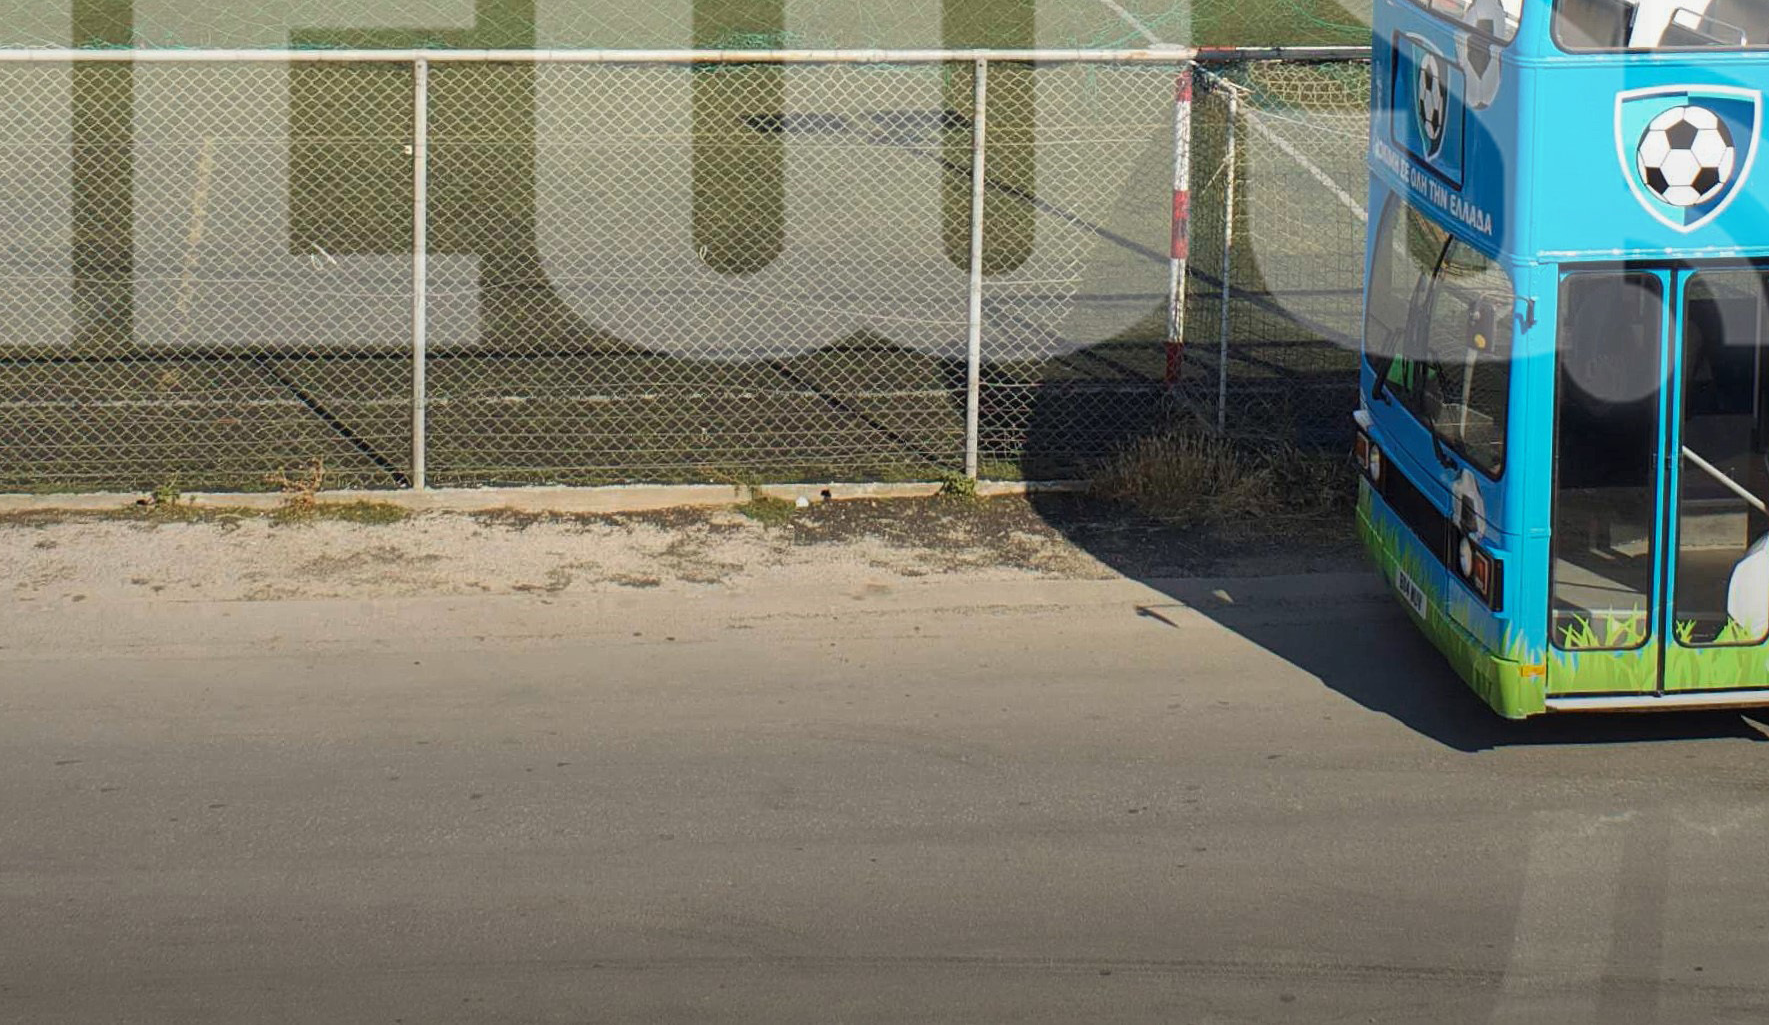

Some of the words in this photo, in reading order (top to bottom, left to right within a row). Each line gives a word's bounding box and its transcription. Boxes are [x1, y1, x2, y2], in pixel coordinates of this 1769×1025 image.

[1410, 168, 1427, 196] ΟΛΗ
[1429, 180, 1448, 209] ΤΗΝ
[1450, 194, 1492, 236] ΕΛΛΑΔΑ
